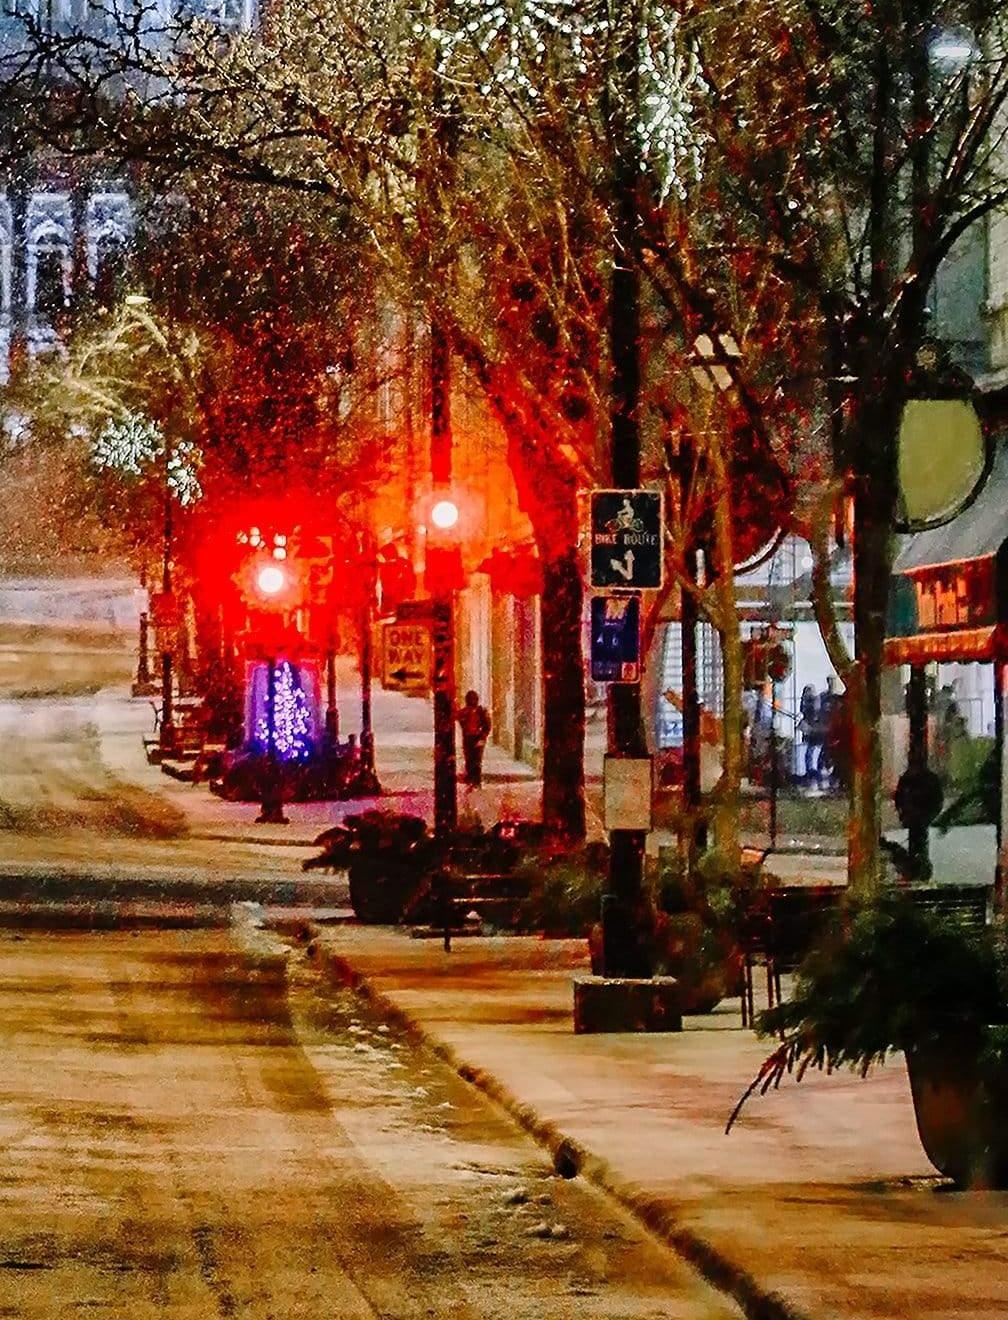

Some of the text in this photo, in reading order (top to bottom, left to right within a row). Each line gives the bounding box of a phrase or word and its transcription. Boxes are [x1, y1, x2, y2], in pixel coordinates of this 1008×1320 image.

[594, 532, 657, 546] BIKE ROUTE
[390, 630, 424, 646] ONE
[388, 648, 423, 664] WAY
